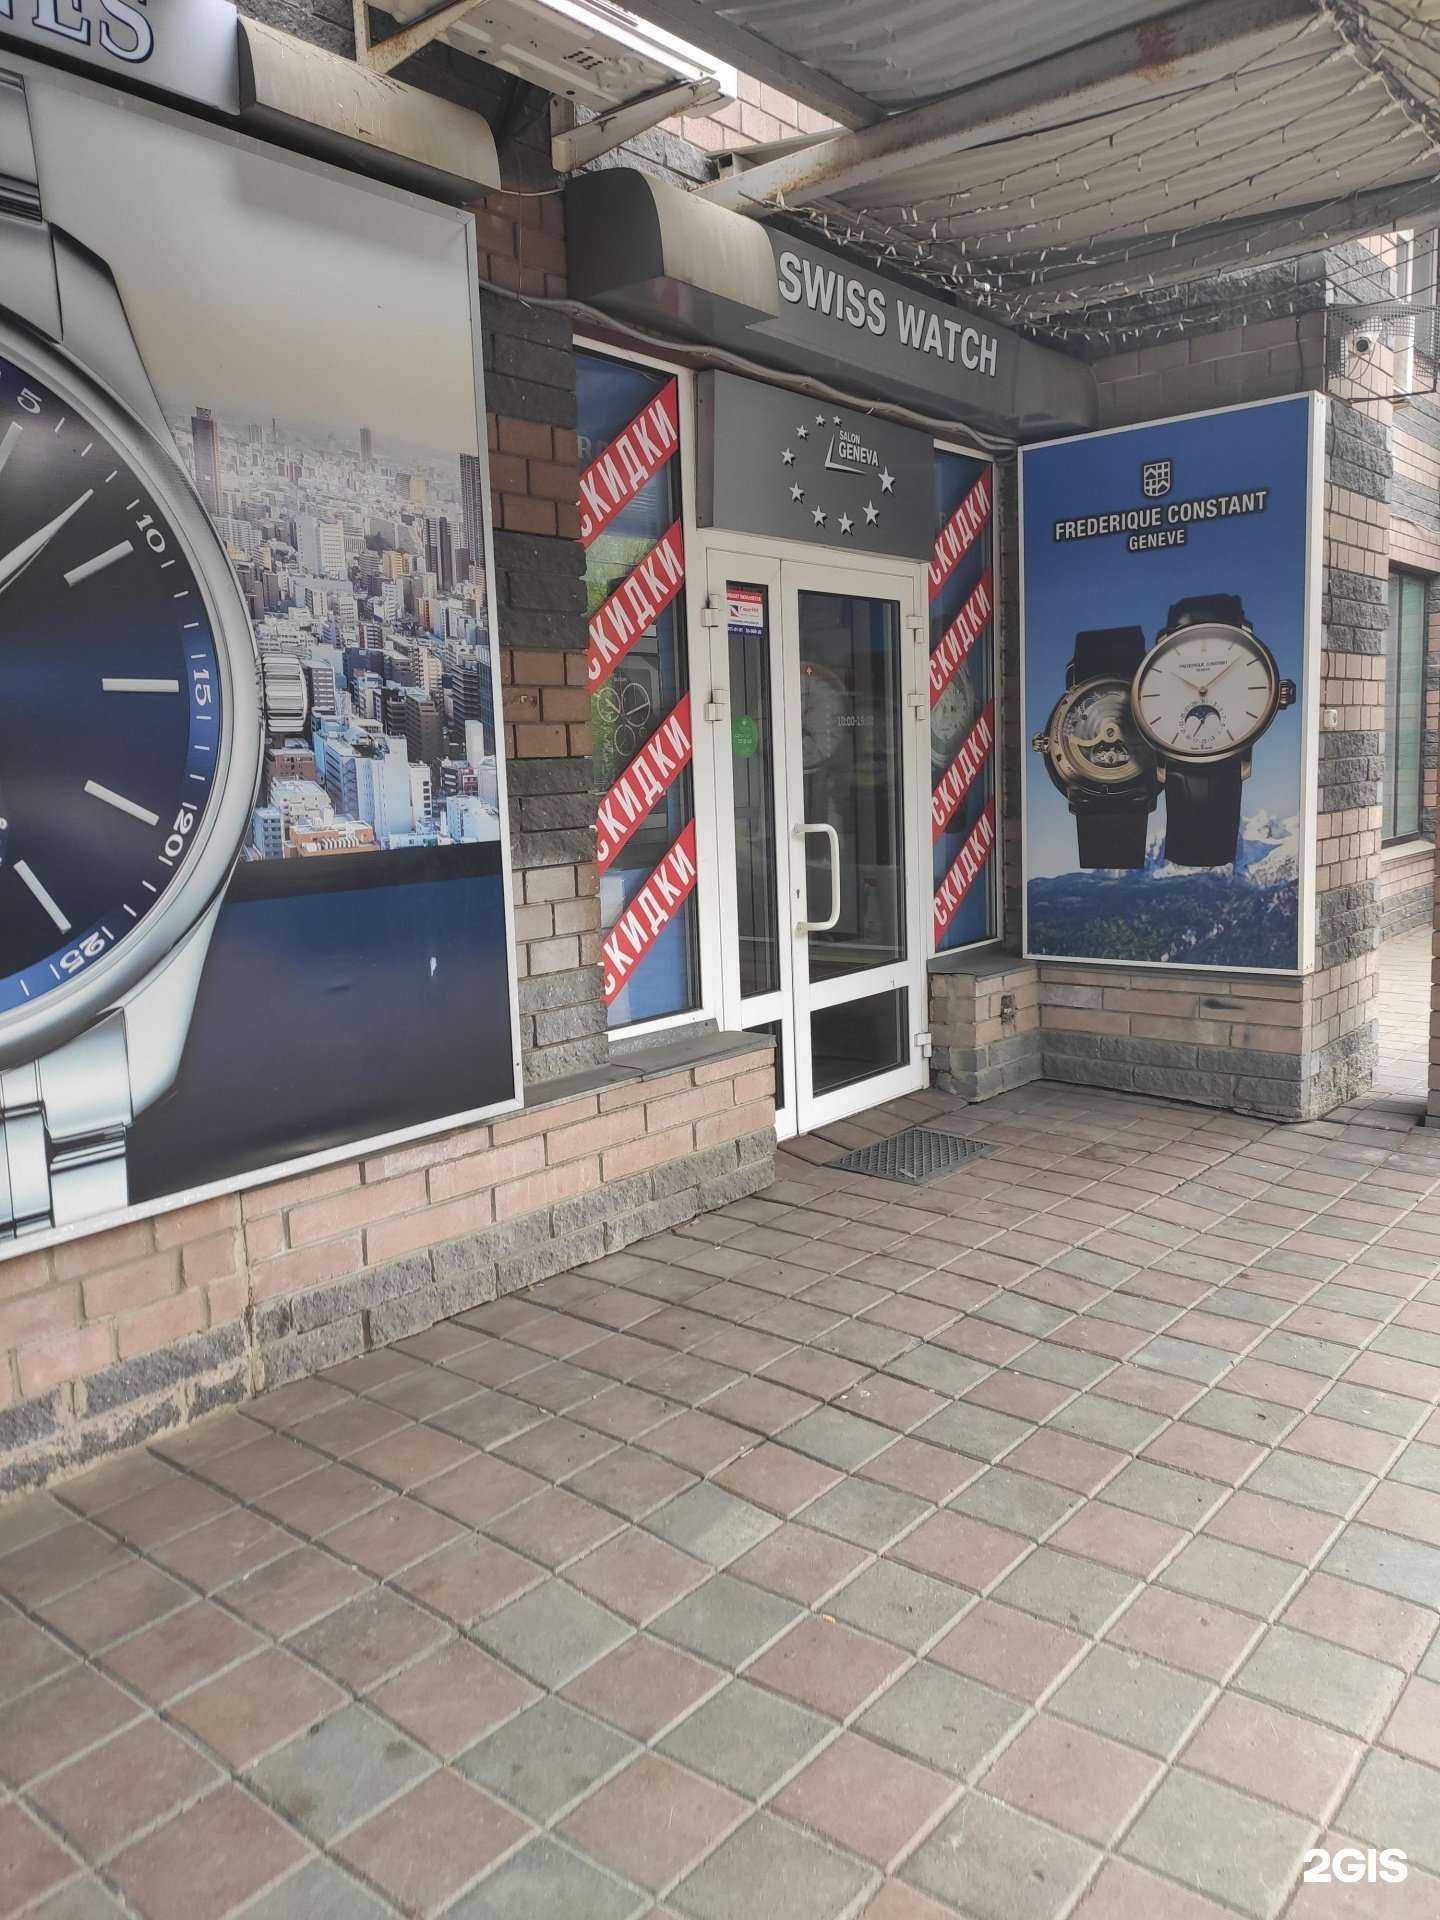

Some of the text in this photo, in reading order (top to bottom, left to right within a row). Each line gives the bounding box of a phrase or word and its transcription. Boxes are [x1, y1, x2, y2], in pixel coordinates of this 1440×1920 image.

[778, 252, 998, 377] SWISS WATCH
[17, 387, 42, 414] 5
[839, 441, 879, 467] GENEVA
[840, 430, 861, 444] SALON
[136, 514, 165, 553] 10
[928, 480, 991, 585] СКИДКИ
[1055, 491, 1267, 540] FREDERIQUE CONSTANT
[1129, 529, 1185, 550] GENEVE
[929, 583, 991, 691] СКИДКИ
[193, 668, 211, 706] 15
[931, 717, 992, 826] СКИДКИ
[165, 808, 193, 857] 20
[934, 814, 994, 926] СКИДКИ
[60, 931, 104, 974] 25
